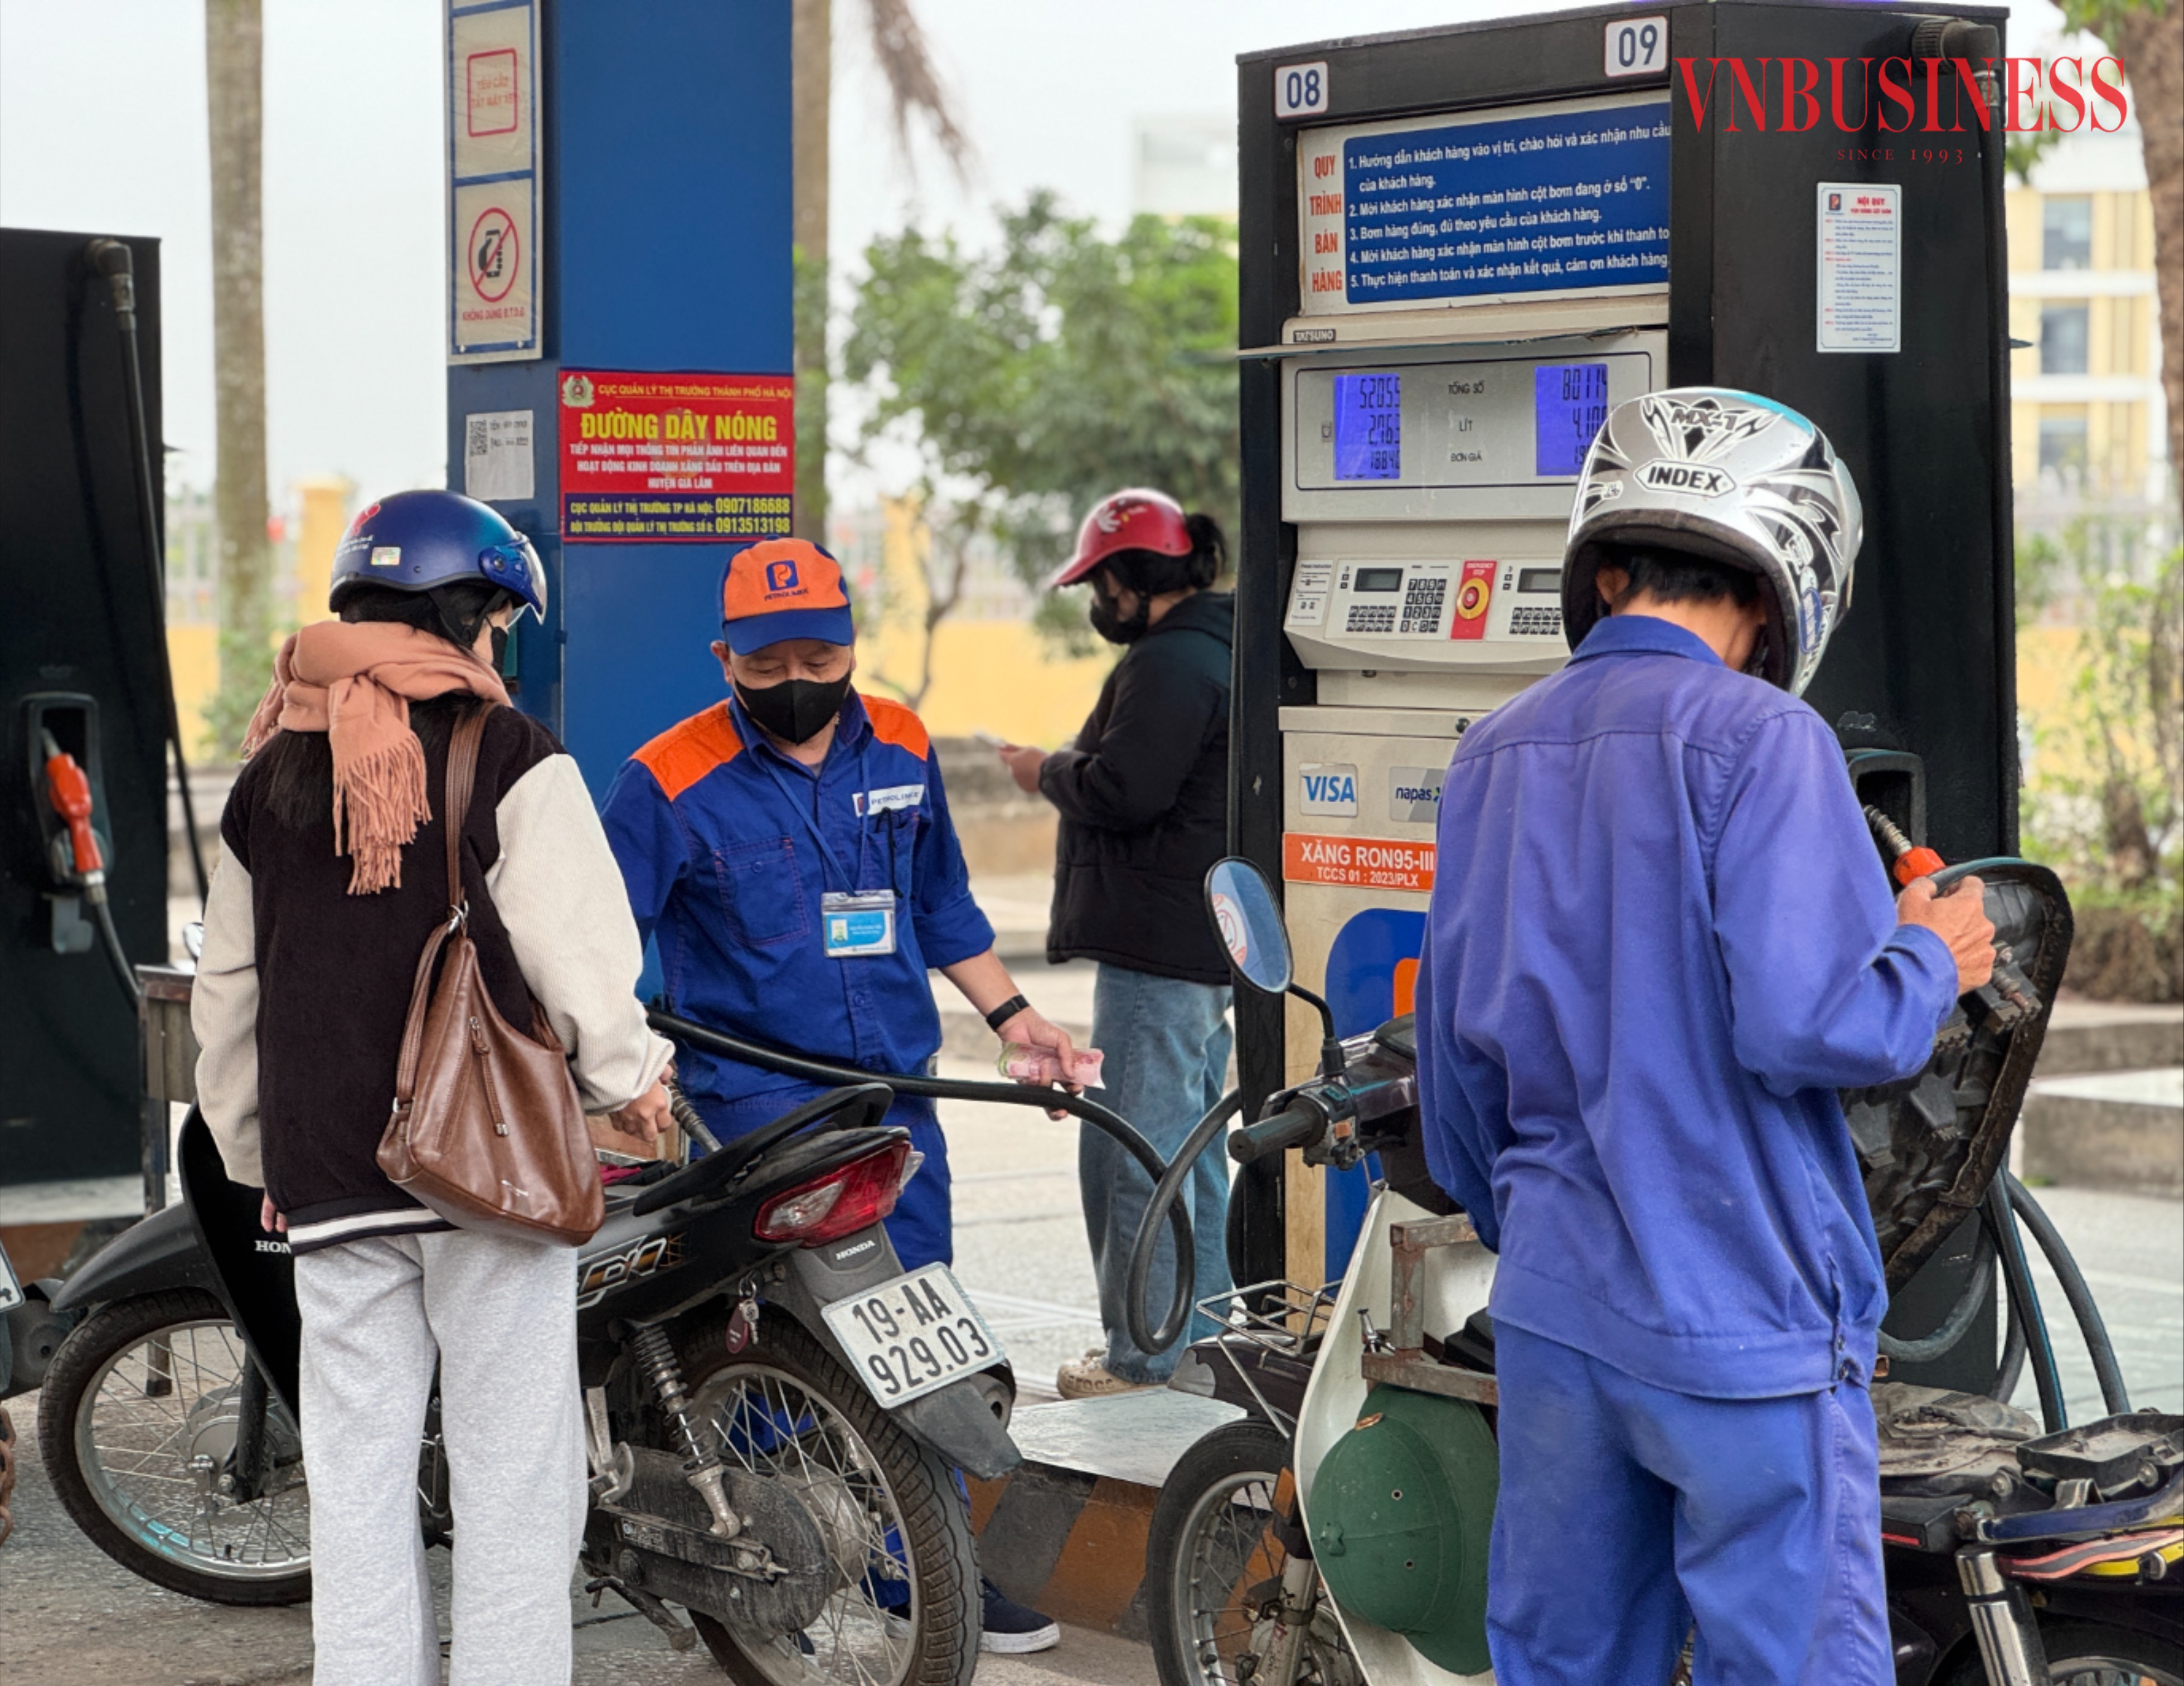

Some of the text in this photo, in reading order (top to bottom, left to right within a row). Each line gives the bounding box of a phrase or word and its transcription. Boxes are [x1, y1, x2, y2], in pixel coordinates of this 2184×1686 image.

[1619, 23, 1657, 67] 09
[1287, 71, 1321, 109] 08
[1359, 154, 1392, 169] Hướng
[1414, 148, 1443, 162] khách
[1445, 146, 1470, 160] hàng
[1473, 143, 1489, 156] vào
[1492, 140, 1502, 156] vị
[1519, 137, 1544, 151] chào
[1546, 133, 1562, 148] hỏi
[1565, 132, 1577, 146] và
[1580, 130, 1598, 144] xác
[1601, 128, 1626, 144] nhận
[1629, 125, 1649, 139] nhu
[1652, 120, 1671, 137] cầu
[1314, 155, 1336, 179] QUY
[1349, 175, 1627, 217] 2. Mời khách hàng xác nhận màn hình cột bơm đang ở số
[1359, 178, 1376, 192] của
[1379, 175, 1407, 190] khách
[1309, 190, 1342, 216] TRÌNH
[1350, 227, 1358, 240] 3.
[1360, 227, 1383, 239] Bơm
[1385, 224, 1409, 239] hàng
[1440, 219, 1452, 232] đủ
[1455, 218, 1476, 231] theo
[1478, 215, 1497, 232] yêu
[1499, 211, 1517, 226] cầu
[1520, 212, 1538, 226] của
[1540, 210, 1570, 224] khách
[1573, 207, 1602, 222] hàng.
[1315, 229, 1338, 254] BÁN
[1350, 227, 1656, 264] 4. Mời khách hàng xác nhận màn hình cột bơm trước khi thanh
[1312, 267, 1342, 292] HÀNG
[1351, 275, 1359, 288] 5.
[1361, 274, 1385, 289] Thực
[1388, 270, 1408, 286] hiện
[1410, 269, 1437, 283] thanh
[1440, 268, 1460, 281] toán
[1463, 265, 1474, 279] và
[1477, 264, 1494, 278] xác
[1497, 261, 1521, 279] nhận
[1523, 258, 1539, 274] kết
[1590, 259, 1604, 269] ơn
[1607, 254, 1638, 268] khách
[598, 385, 617, 396] CỤC
[619, 382, 643, 394] QUẢN
[646, 384, 657, 395] LÝ
[743, 385, 761, 397] PHỐ
[764, 386, 775, 398] HÀ
[1448, 380, 1484, 394] TỔNG SỐ
[580, 406, 776, 440] ĐƯỜNG DÂY NÓNG
[1458, 417, 1473, 432] LÍT
[1647, 466, 1722, 492] INDEX
[715, 497, 790, 513] 0907186688
[715, 517, 790, 533] 0913513198
[1301, 775, 1355, 802] VISA
[1396, 787, 1432, 803] napas
[1301, 839, 1434, 871] XĂNG RON95-III
[1317, 866, 1419, 886] TCCS 01 2023/PLX
[836, 1240, 876, 1261] HONDA
[852, 1277, 952, 1344] 19-AA
[868, 1317, 989, 1394] 929.03
